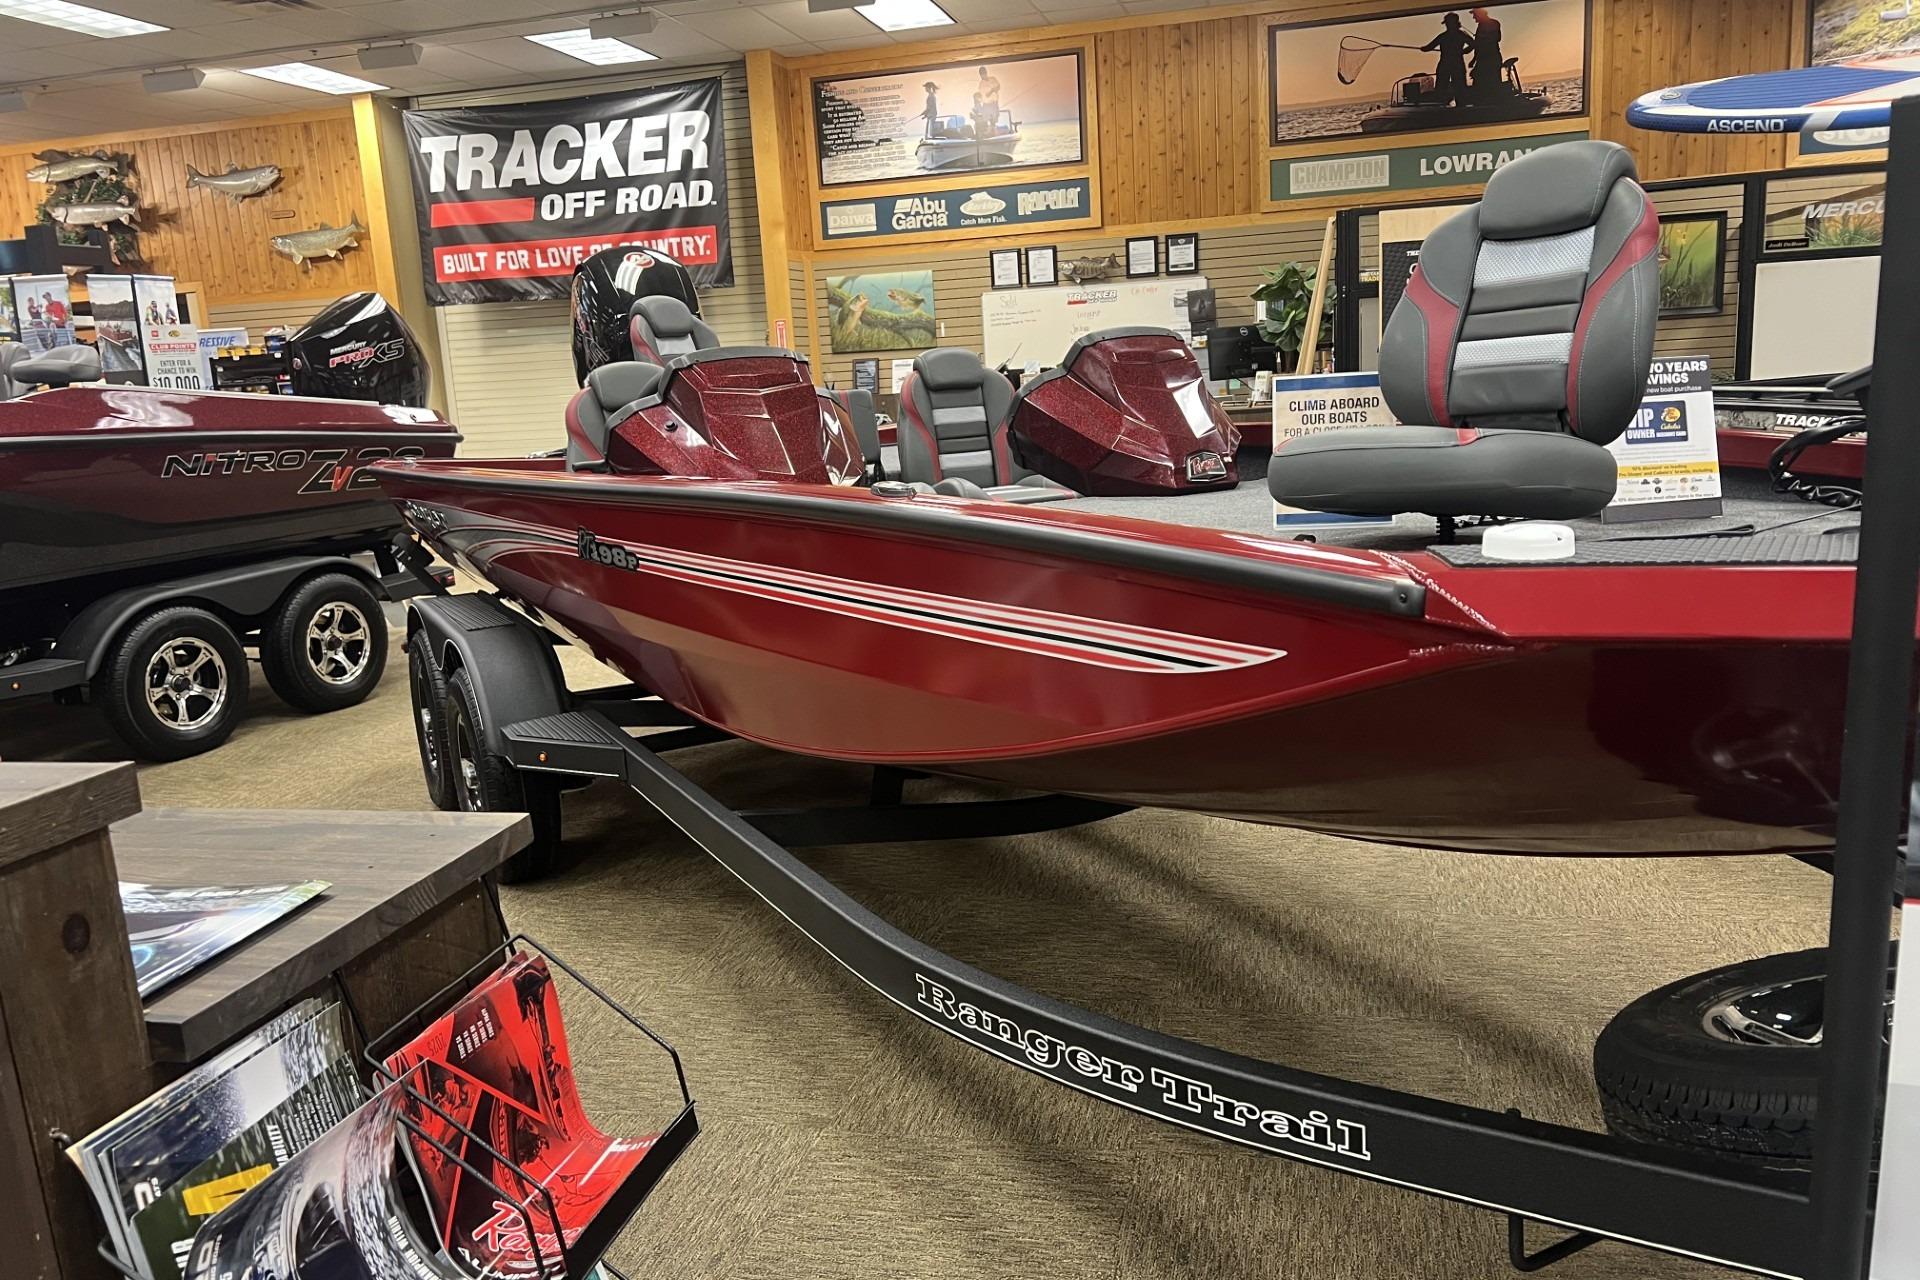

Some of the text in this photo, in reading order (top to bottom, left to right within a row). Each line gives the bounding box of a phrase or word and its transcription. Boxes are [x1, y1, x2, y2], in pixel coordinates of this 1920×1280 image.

[1706, 119, 1785, 132] ASCEND
[420, 110, 711, 193] TRACKER
[1420, 148, 1535, 176] LOWRAN
[1294, 160, 1385, 184] CHAMPION
[540, 179, 717, 221] OFF ROAD.
[911, 197, 948, 215] Abu
[1801, 200, 1885, 219] MERC
[892, 212, 948, 230] Garcia
[443, 252, 488, 275] BUILT
[496, 249, 530, 272] FOR
[535, 245, 583, 269] LOVE
[620, 234, 712, 257] NTRY.
[1067, 289, 1118, 300] TRACKER
[330, 341, 366, 355] MERCURY
[1665, 361, 1707, 372] YEARS
[1647, 372, 1689, 385] VINGS
[1289, 396, 1380, 412] CLIMB ABOARD
[1301, 411, 1367, 425] OUR BOATS
[1776, 413, 1832, 428] TRACK
[1284, 428, 1303, 437] FOR
[1626, 429, 1655, 440] OWNER
[161, 450, 307, 478] NITRO
[916, 973, 1371, 1160] Ranger Trail
[404, 1248, 443, 1280] AMPION
